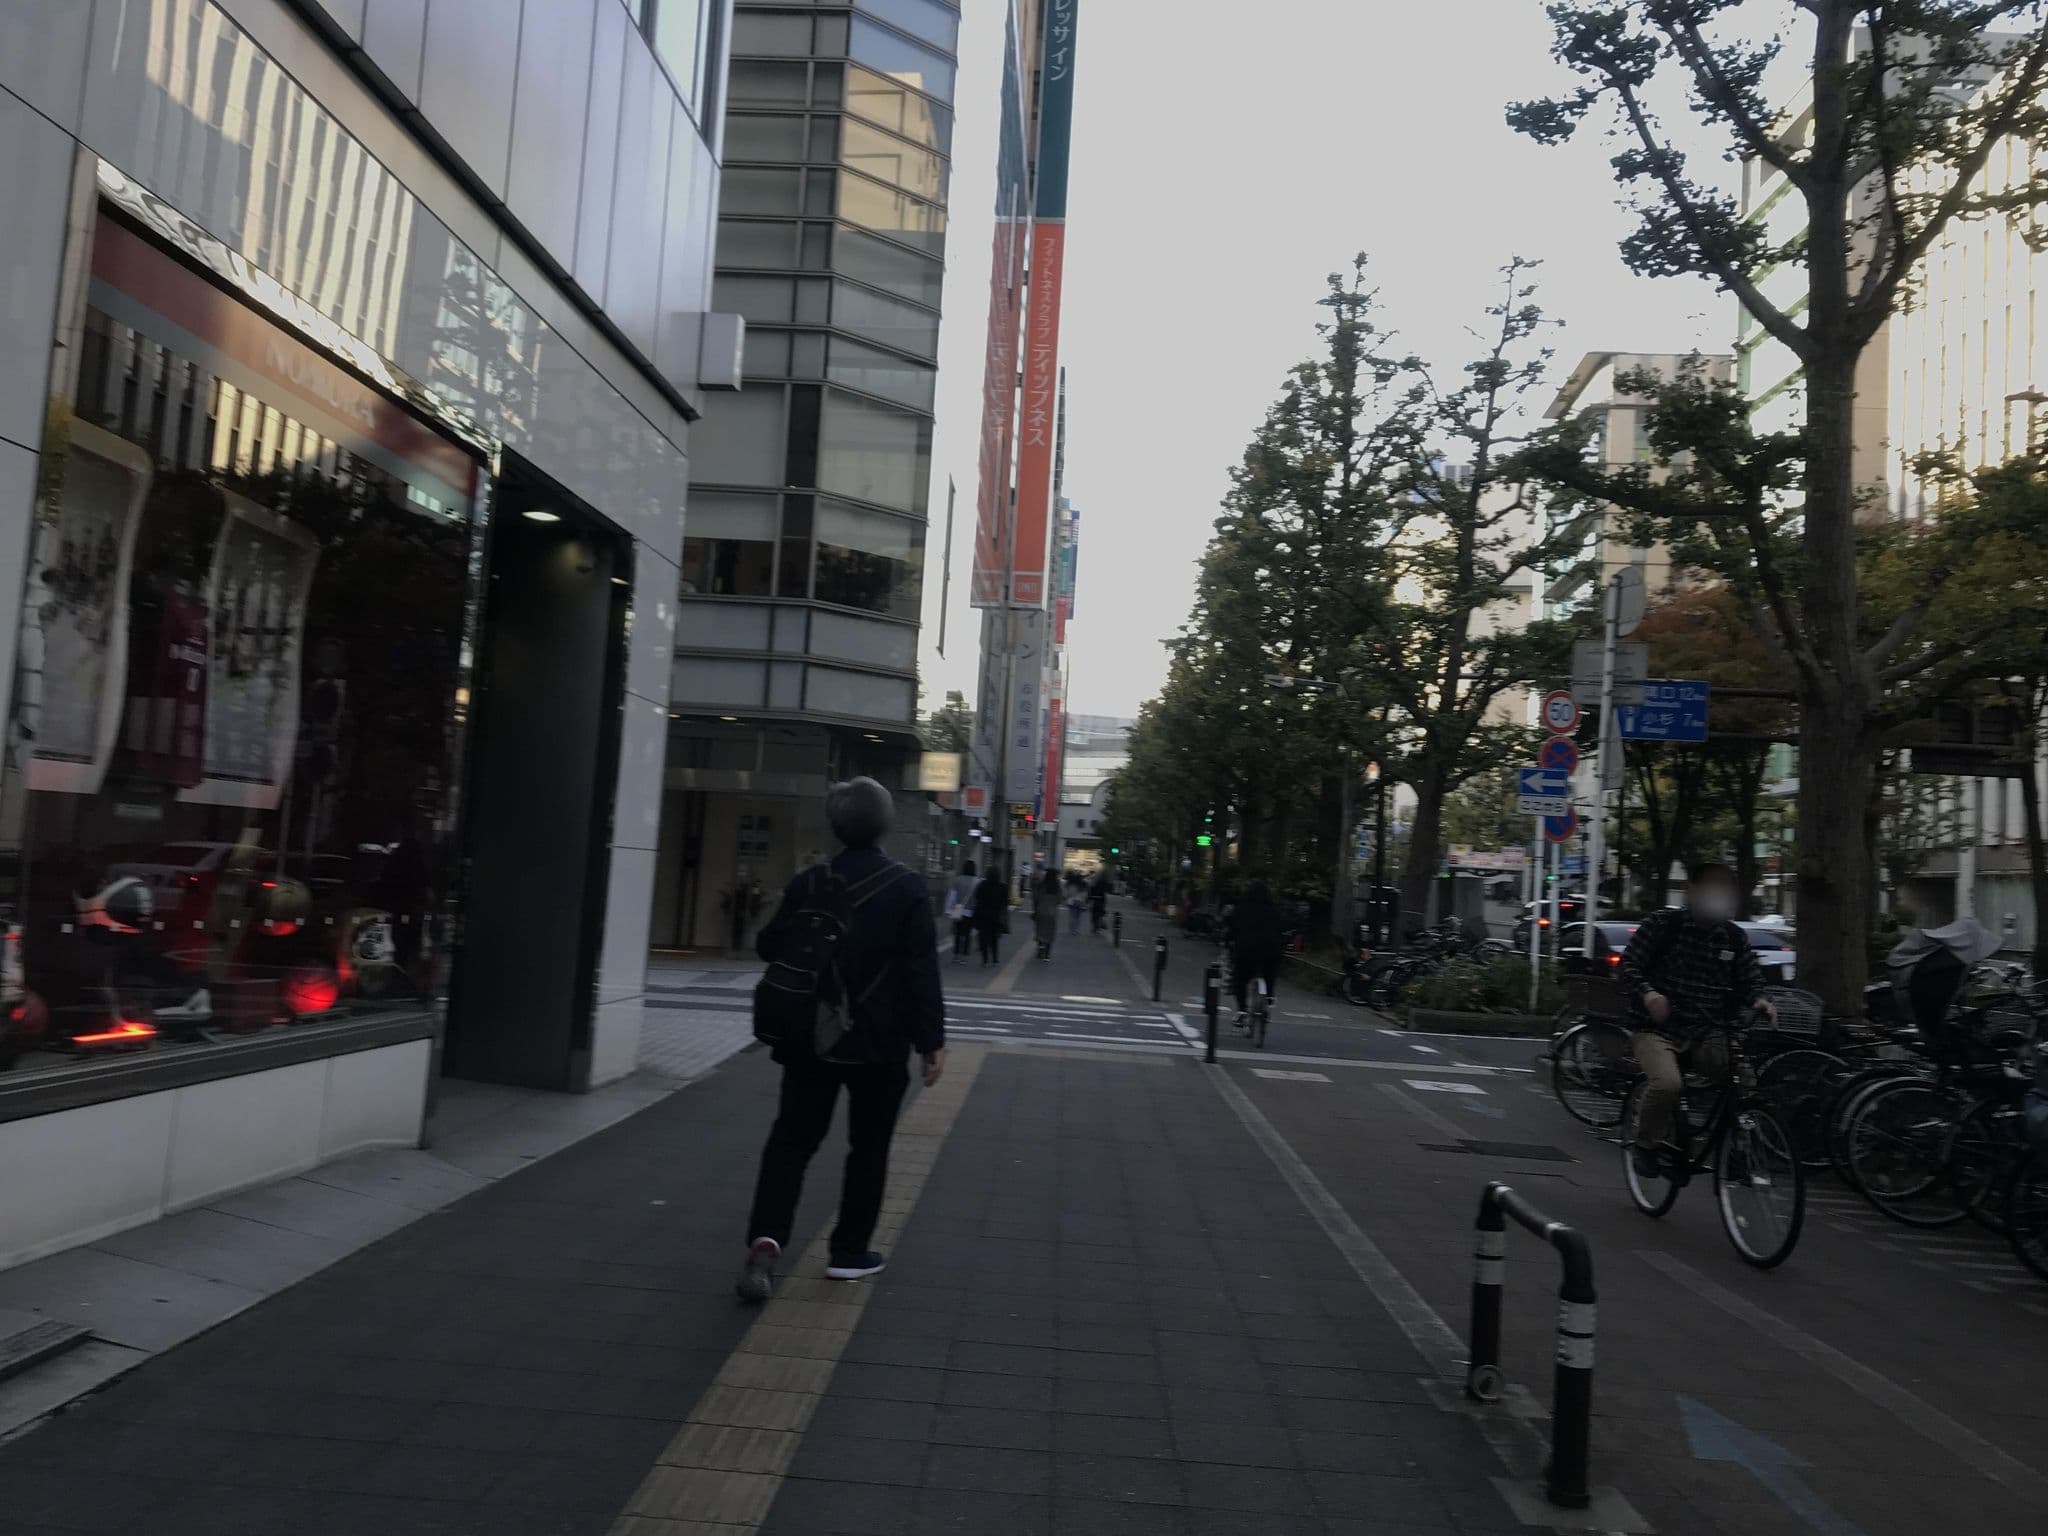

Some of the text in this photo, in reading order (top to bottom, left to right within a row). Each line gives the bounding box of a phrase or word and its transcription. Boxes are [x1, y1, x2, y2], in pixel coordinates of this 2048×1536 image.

[1050, 0, 1072, 80] レッサイン
[1026, 343, 1053, 446] ティップネス
[1550, 702, 1571, 722] 50
[1520, 800, 1565, 813] ここから
